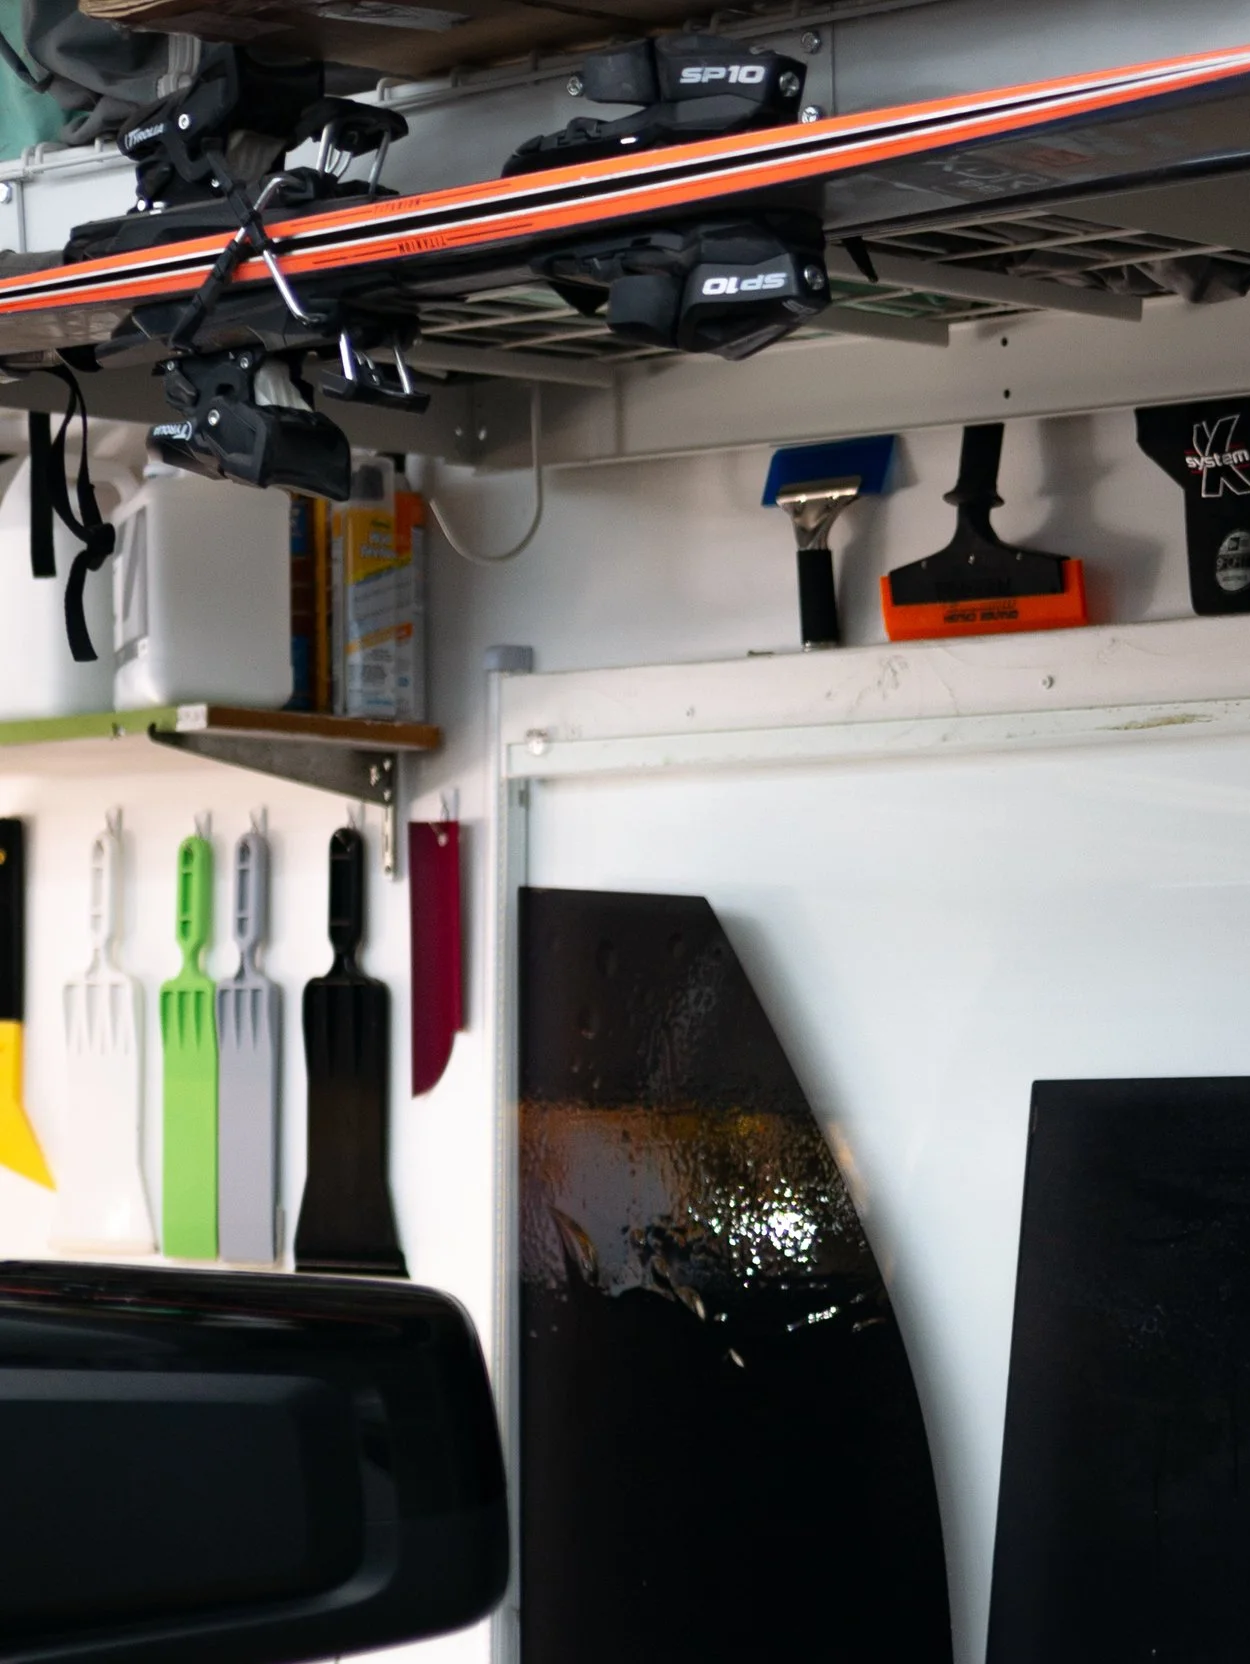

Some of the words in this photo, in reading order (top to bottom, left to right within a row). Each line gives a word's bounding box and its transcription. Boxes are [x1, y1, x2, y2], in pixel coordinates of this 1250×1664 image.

[679, 65, 766, 84] SP10
[702, 273, 788, 296] SP10
[1185, 447, 1250, 472] system
